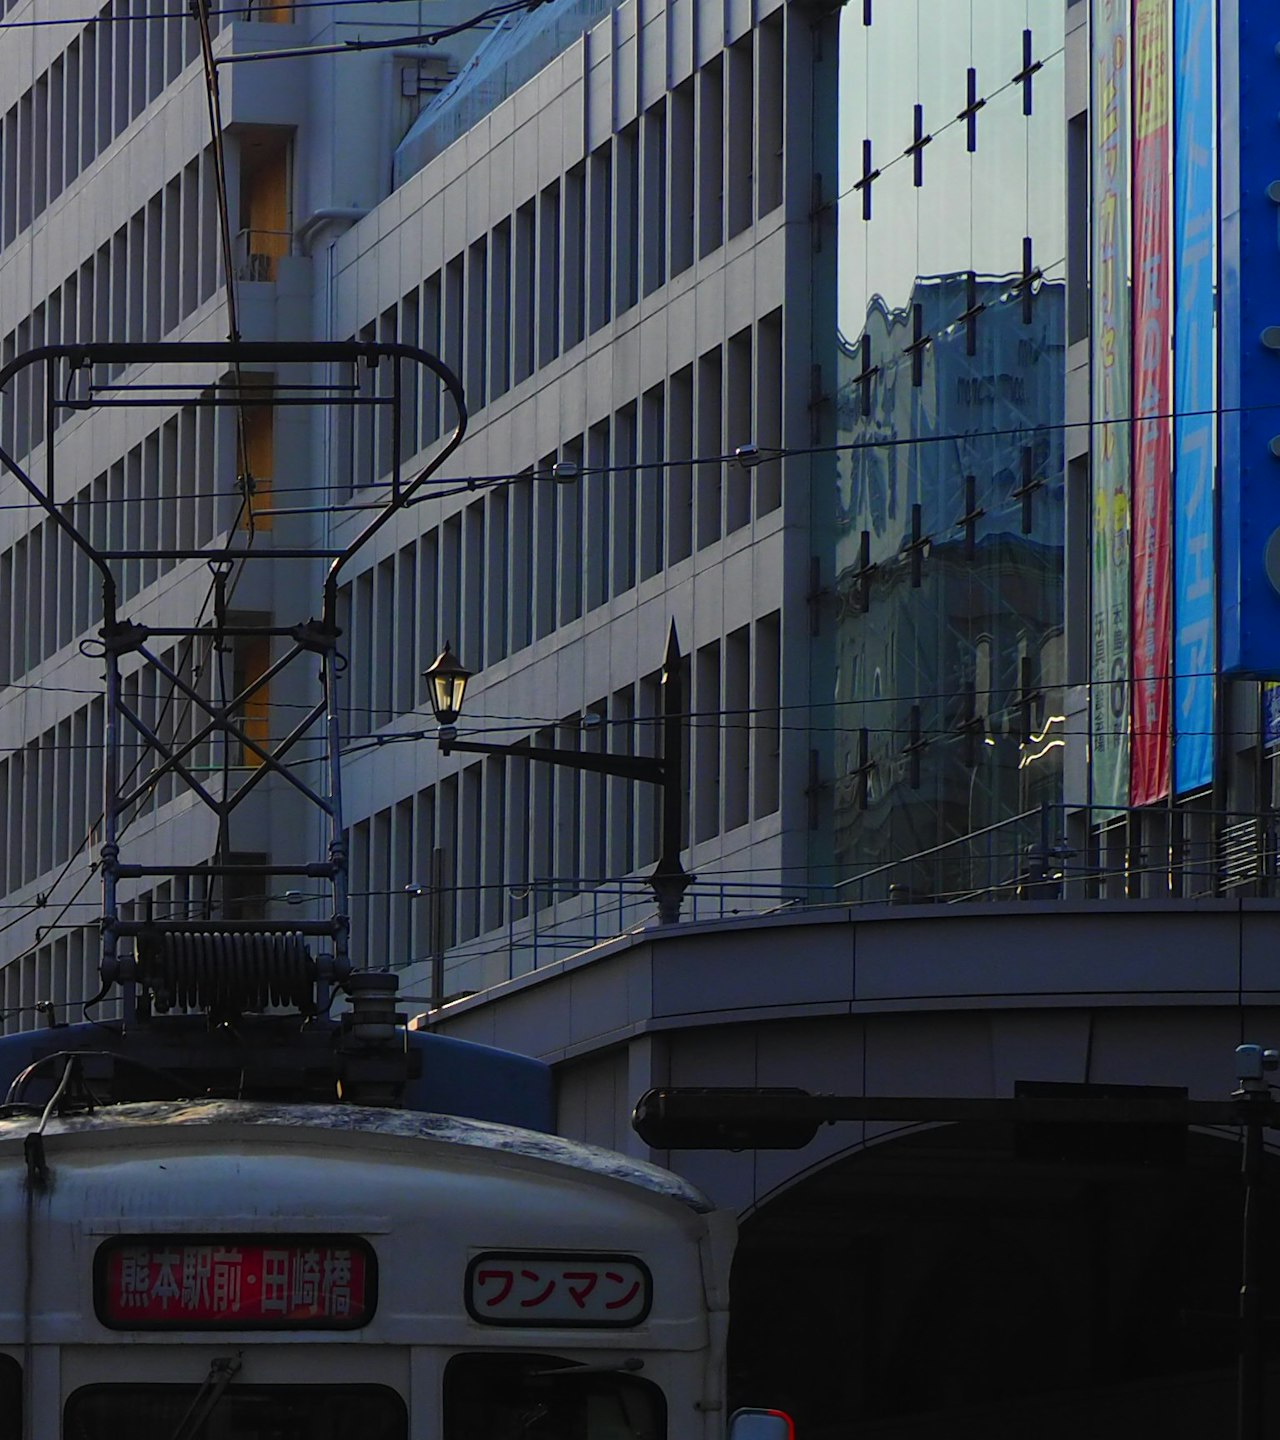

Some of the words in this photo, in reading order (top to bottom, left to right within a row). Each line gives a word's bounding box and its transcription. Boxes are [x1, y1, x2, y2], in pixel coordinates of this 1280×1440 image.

[119, 1248, 353, 1318] 熊本駅前・田崎橋
[476, 1269, 642, 1310] ワンマン
